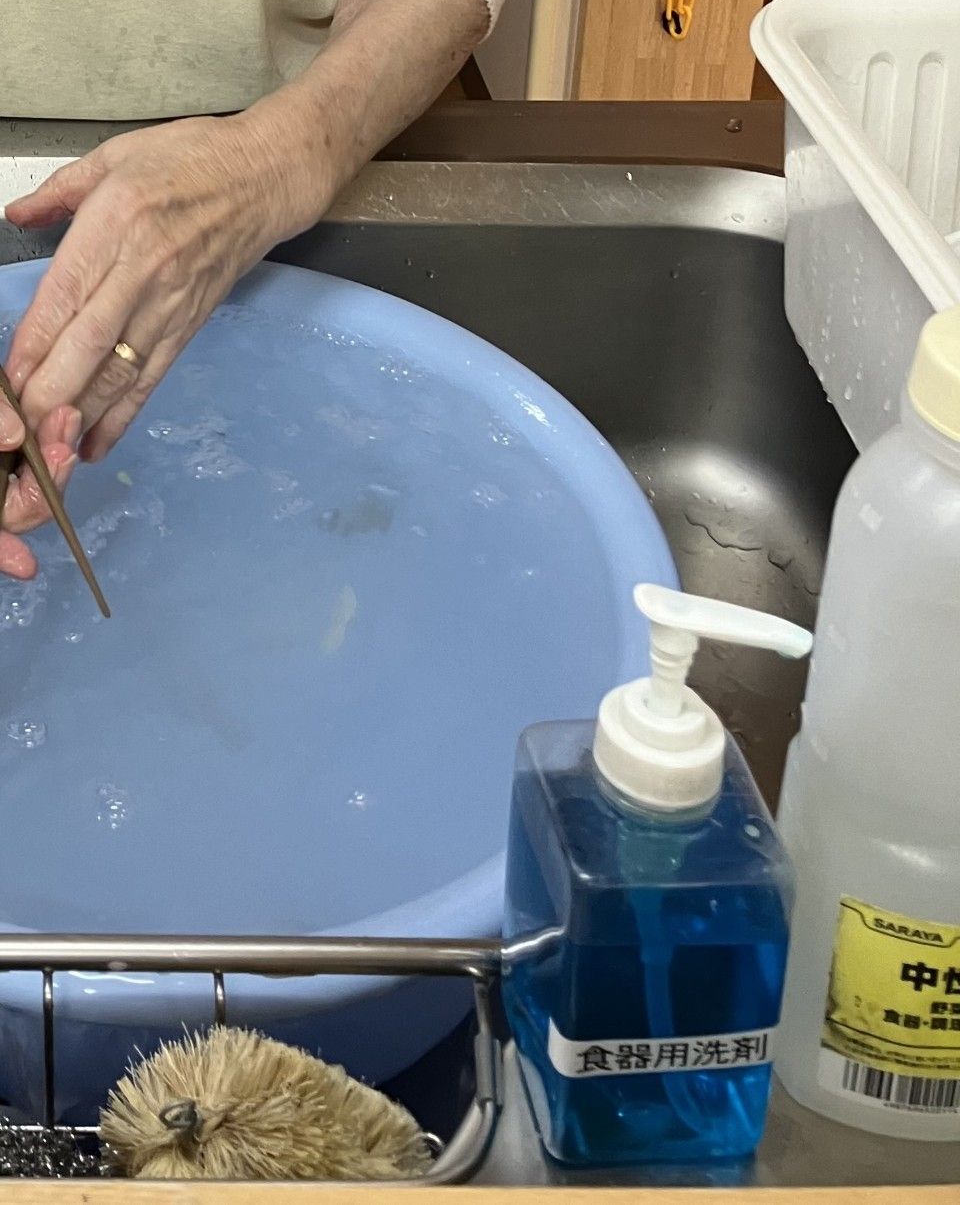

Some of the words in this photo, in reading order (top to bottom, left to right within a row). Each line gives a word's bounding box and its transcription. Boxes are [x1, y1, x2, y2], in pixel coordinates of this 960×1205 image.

[873, 917, 944, 943] SARAYA
[576, 1033, 768, 1074] 食器用洗剤
